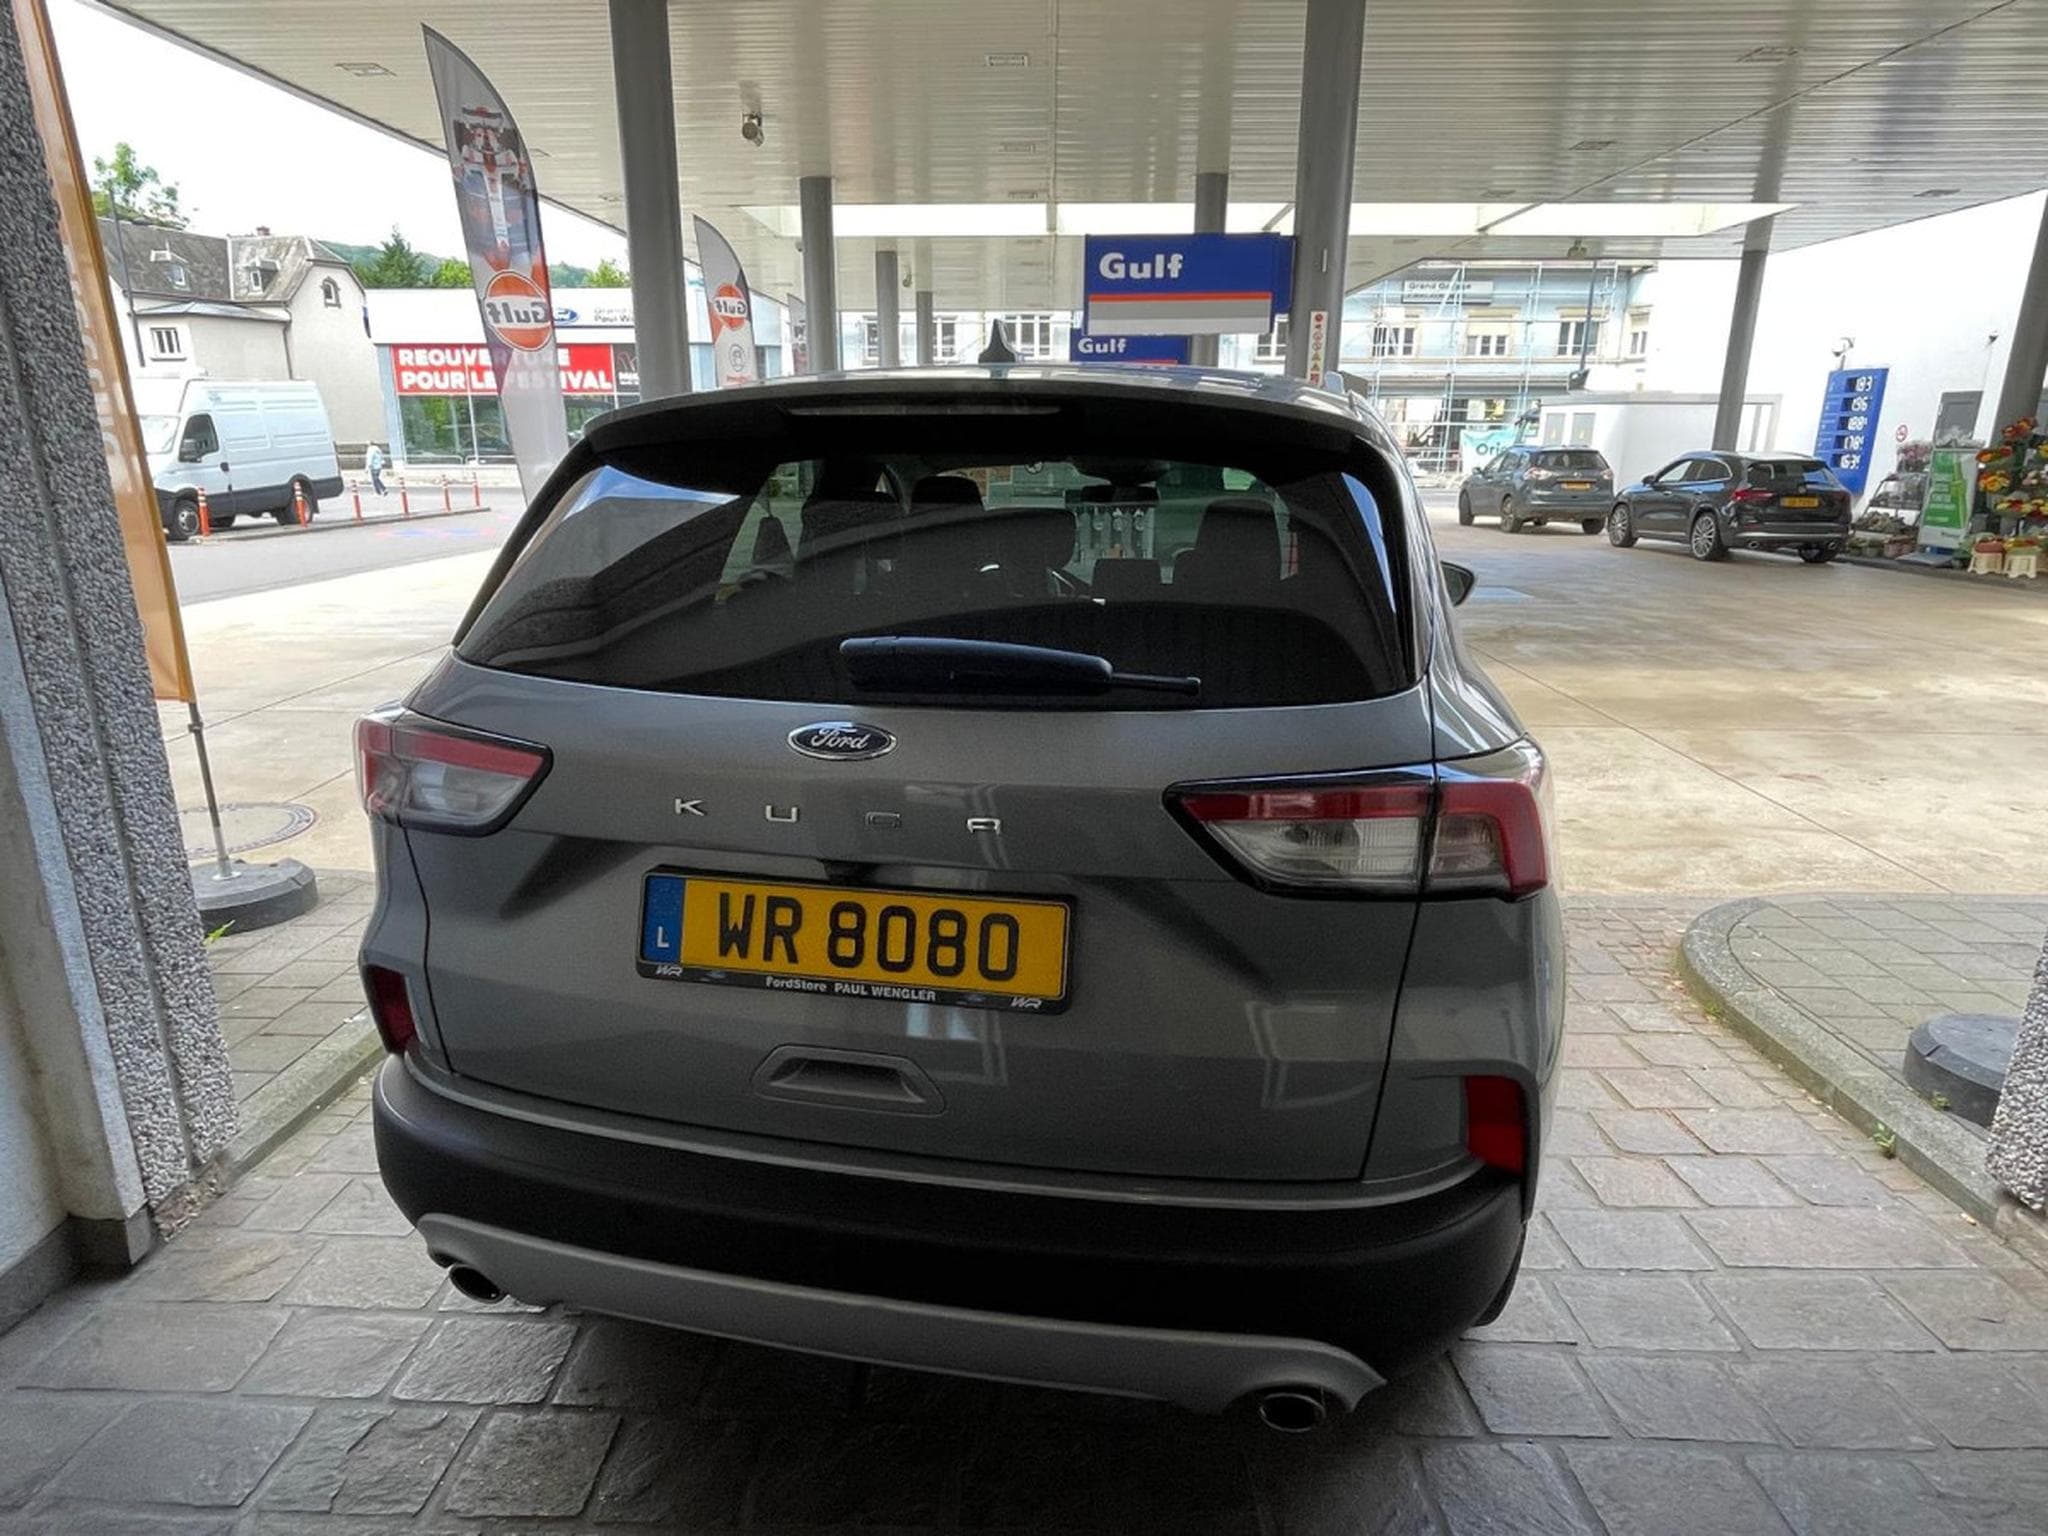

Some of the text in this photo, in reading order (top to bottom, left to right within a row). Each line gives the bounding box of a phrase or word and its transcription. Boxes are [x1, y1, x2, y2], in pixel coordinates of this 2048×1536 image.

[1099, 252, 1184, 280] Gulf
[1078, 338, 1127, 354] Gulf
[402, 371, 466, 390] POUR
[471, 371, 498, 390] LE
[811, 727, 872, 750] Ford
[675, 798, 1001, 834] KUGA
[656, 926, 670, 948] L
[718, 892, 1019, 982] WR 8080
[766, 976, 936, 1002] FordStore PAUL WENGLER
